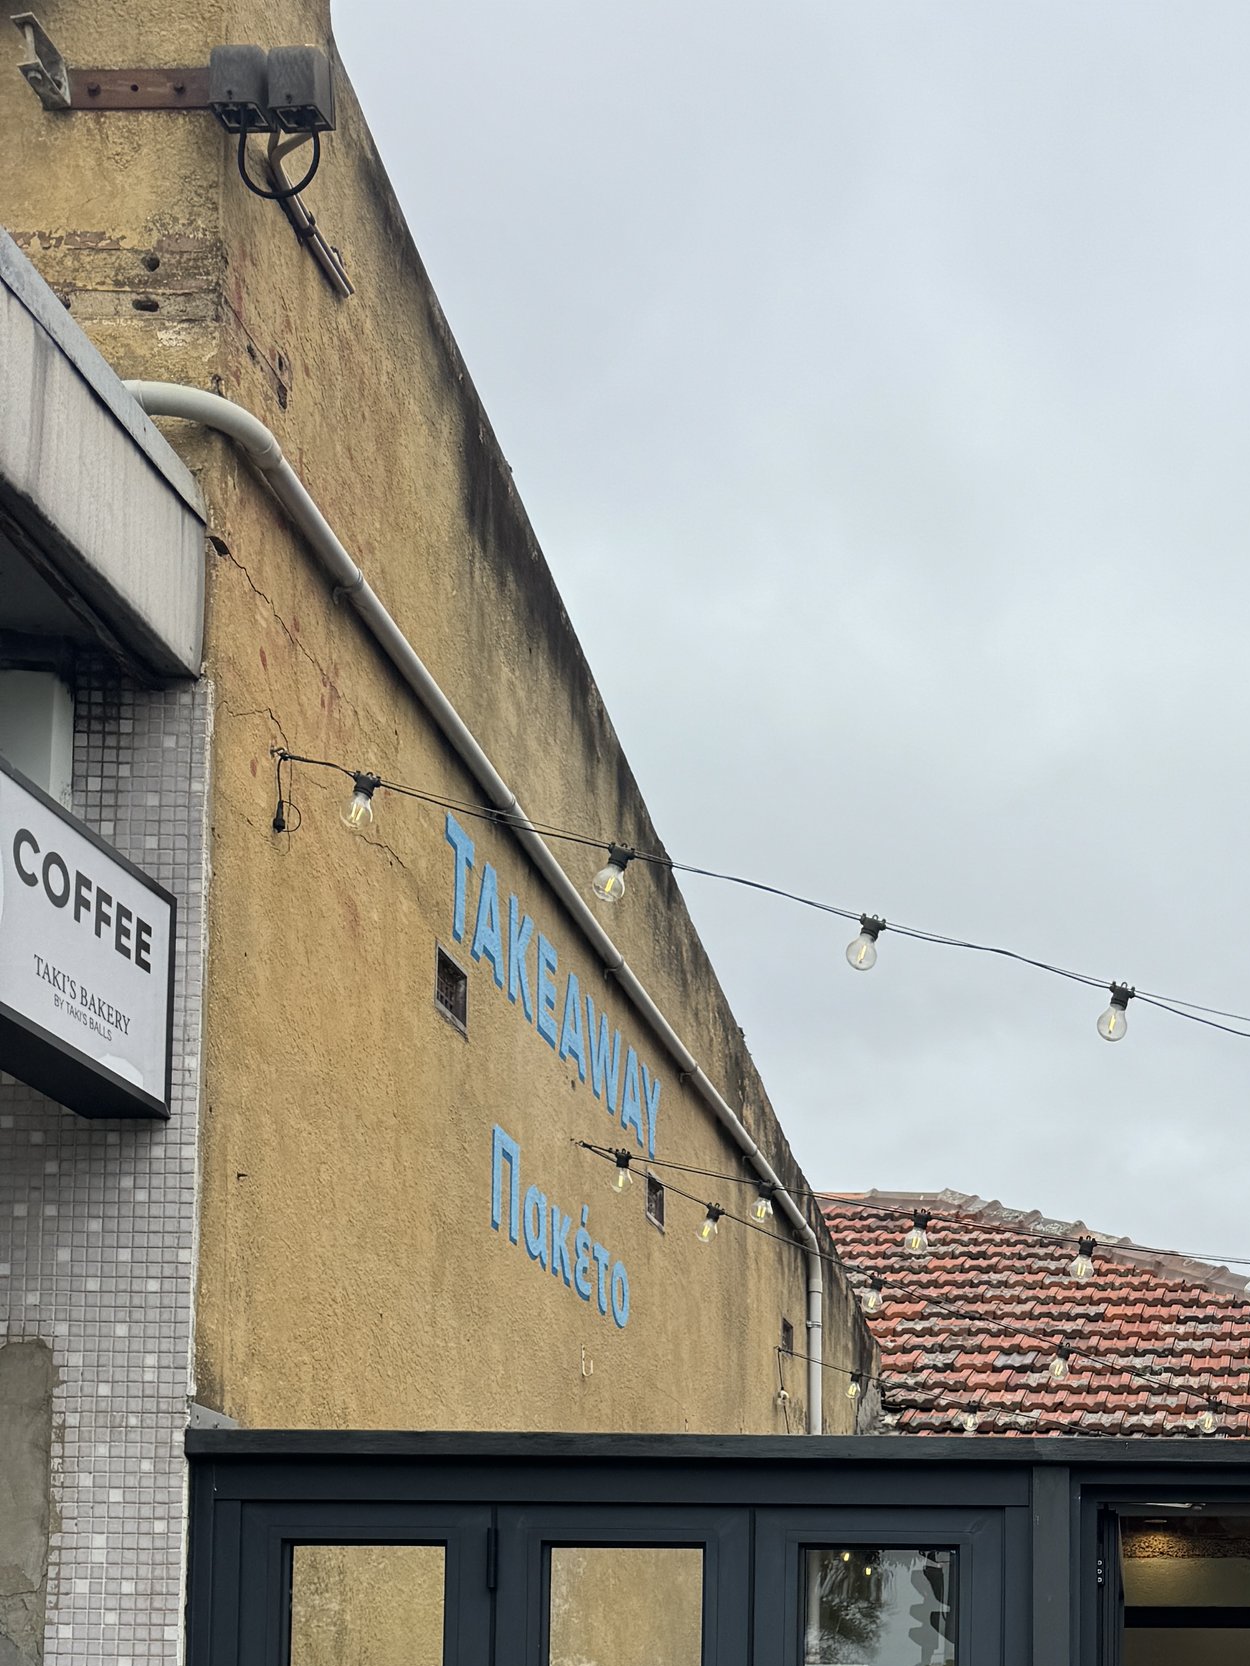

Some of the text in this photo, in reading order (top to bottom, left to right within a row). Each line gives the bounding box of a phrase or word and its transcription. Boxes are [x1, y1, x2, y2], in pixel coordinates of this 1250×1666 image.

[13, 828, 153, 975] COFFEE
[33, 953, 131, 1035] TAKI'S BAKERY
[53, 993, 113, 1042] BY TAKI'S BALLS
[445, 811, 661, 1160] TAKEAWAY
[490, 1123, 630, 1329] Πακέτο
